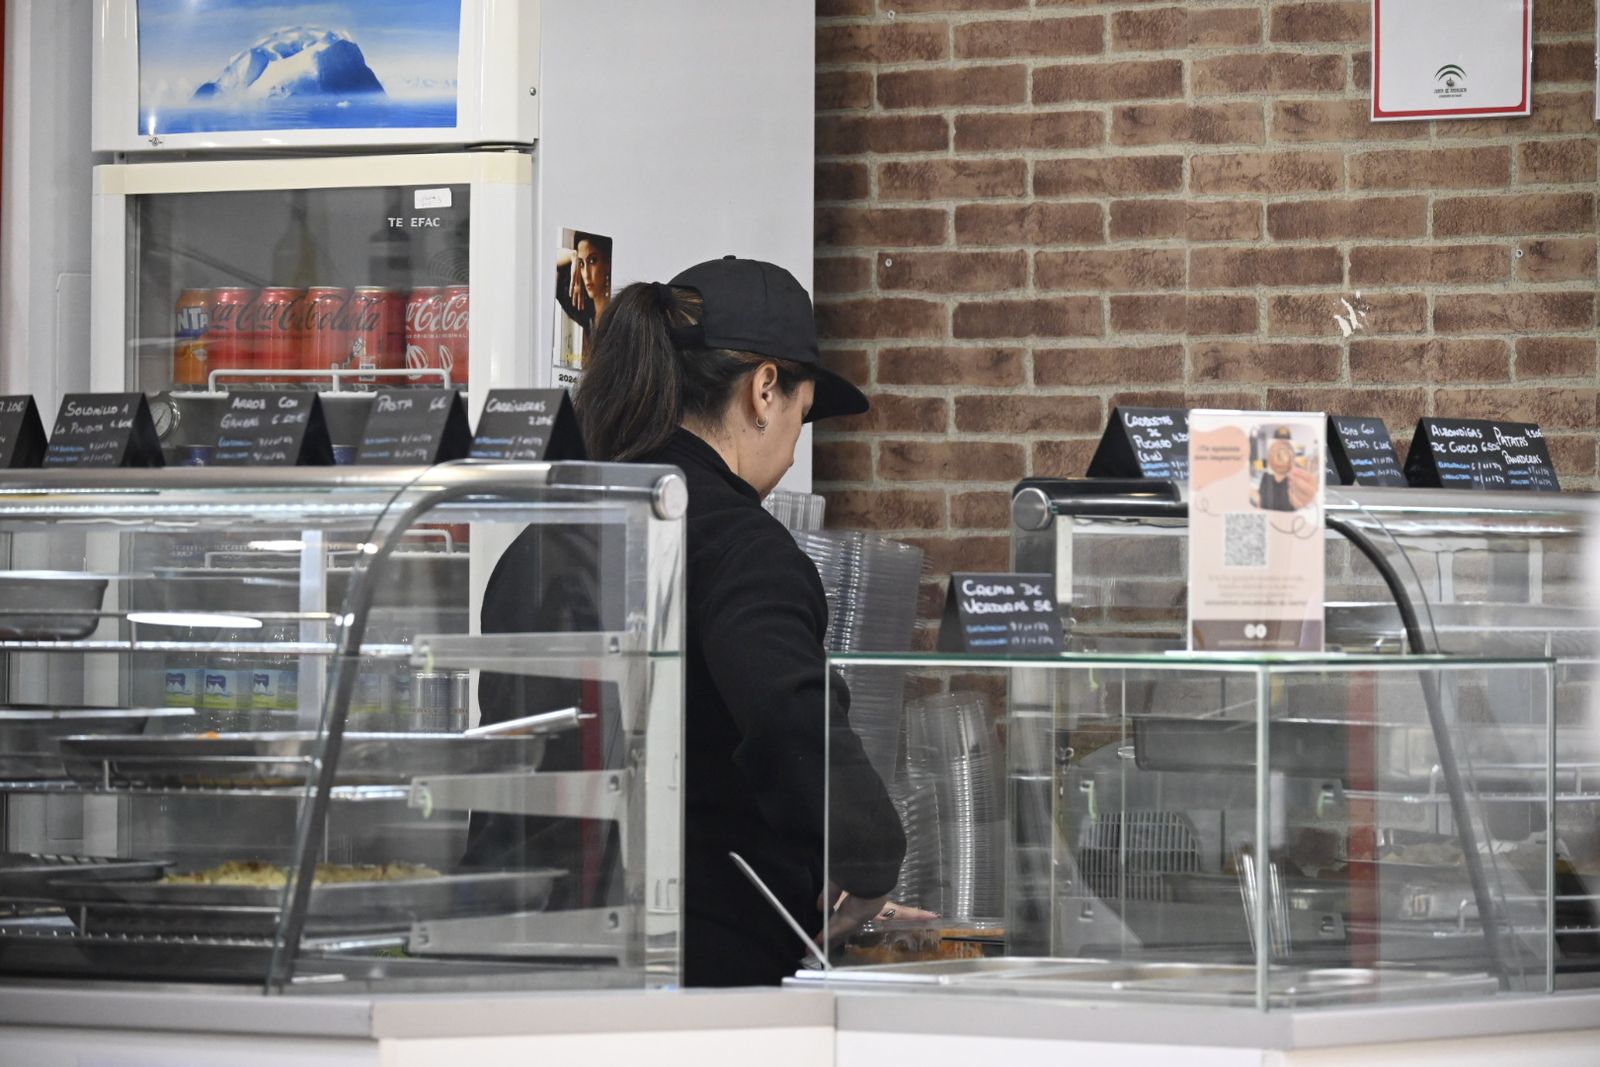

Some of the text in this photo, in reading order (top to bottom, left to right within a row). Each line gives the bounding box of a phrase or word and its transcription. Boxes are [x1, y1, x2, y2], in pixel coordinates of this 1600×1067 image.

[387, 217, 441, 228] TE EFAC
[121, 403, 129, 415] A
[1492, 426, 1529, 448] PATATAS
[1448, 440, 1479, 453] CHOCO
[962, 579, 1015, 597] CREMA
